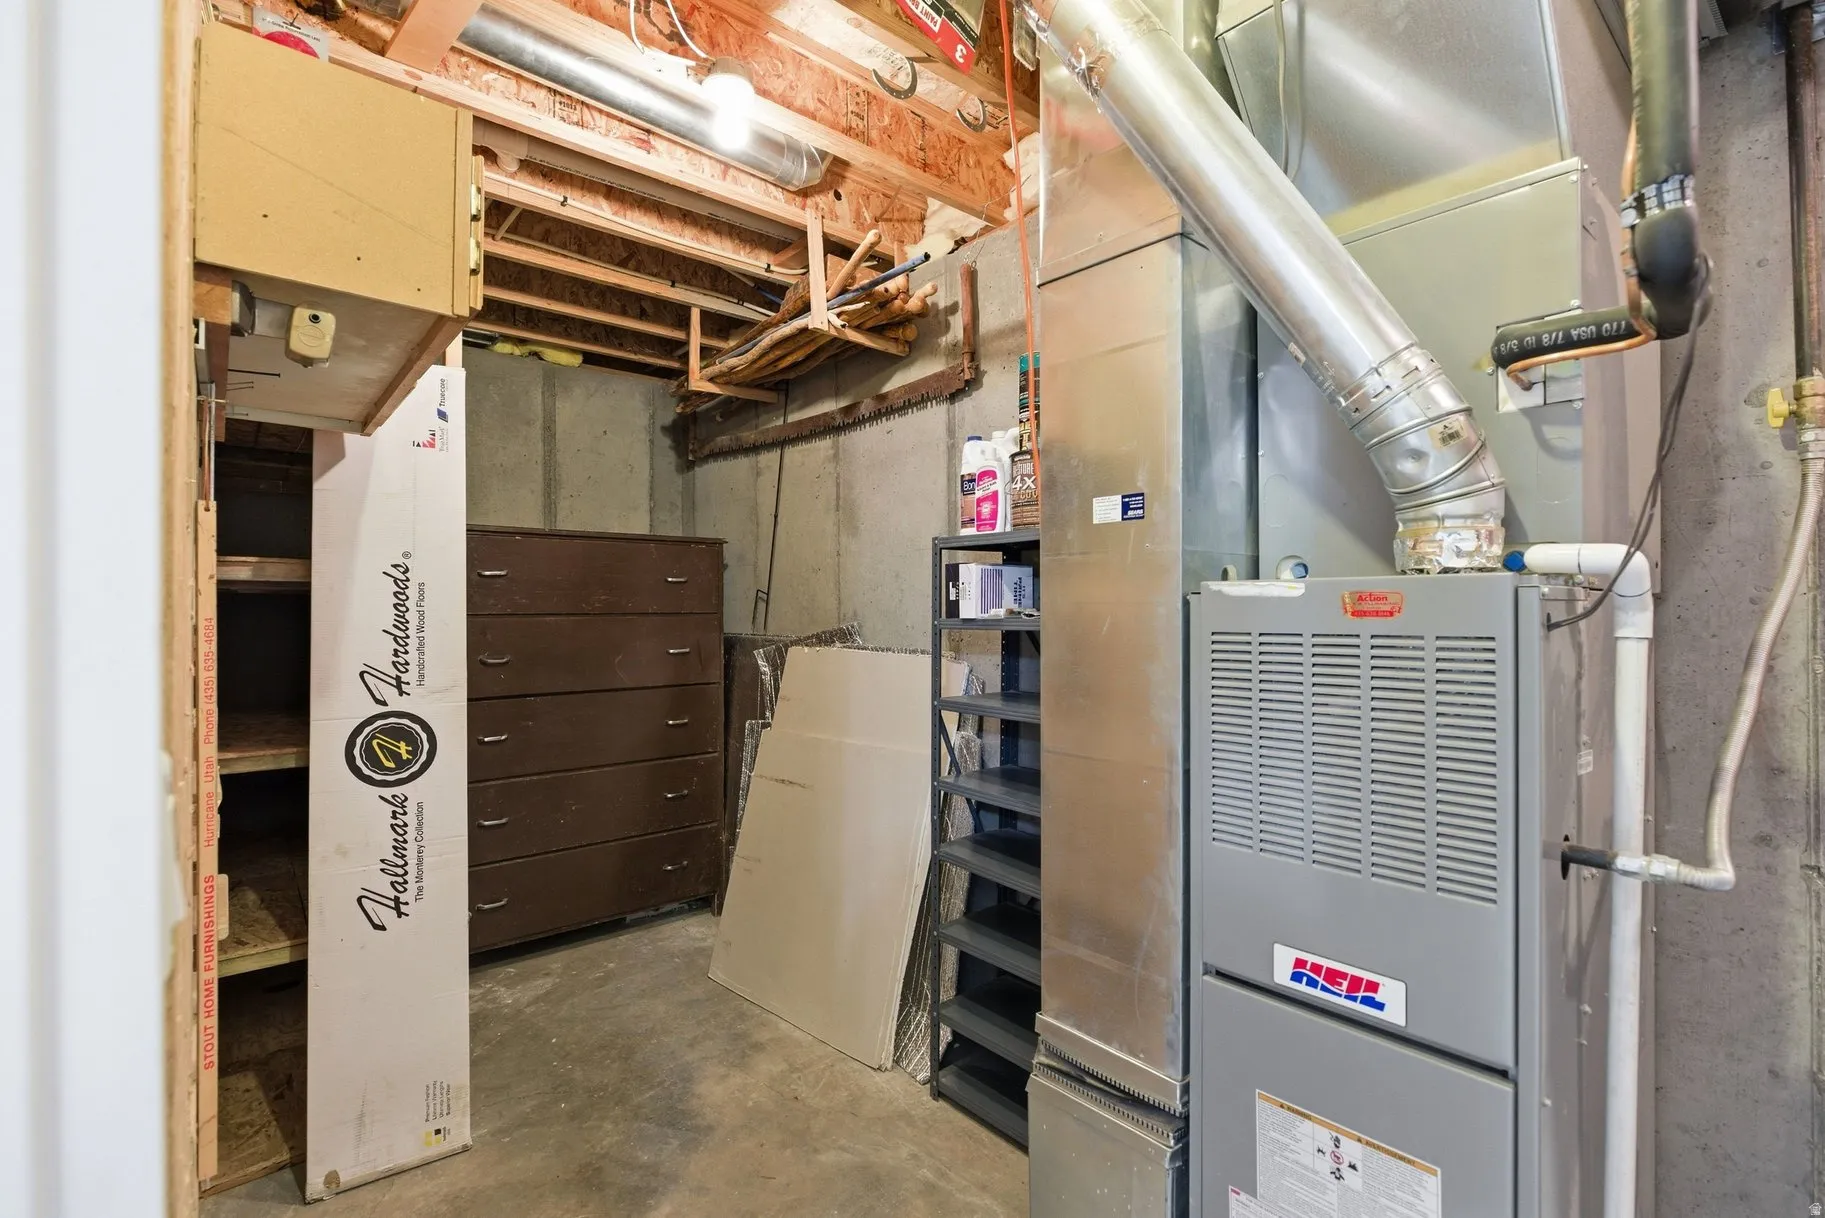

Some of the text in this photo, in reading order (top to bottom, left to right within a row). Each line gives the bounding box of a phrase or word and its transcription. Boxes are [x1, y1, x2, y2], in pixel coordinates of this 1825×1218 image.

[919, 10, 938, 28] PAINT
[954, 44, 967, 64] 3
[1542, 330, 1565, 346] 7/8
[1570, 325, 1597, 341] USA
[1012, 475, 1036, 490] 4X
[1356, 592, 1388, 602] Action
[359, 560, 410, 707] Hardwoods
[416, 582, 426, 687] Handcrafted Wood Floors
[204, 617, 215, 1070] STOUT HOME FURNISHINGS Hurricane Utah Phone (435) 635-4684
[356, 792, 410, 932] Hallmark
[414, 801, 426, 904] The Monterey Collection
[1290, 956, 1386, 1012] HEIL
